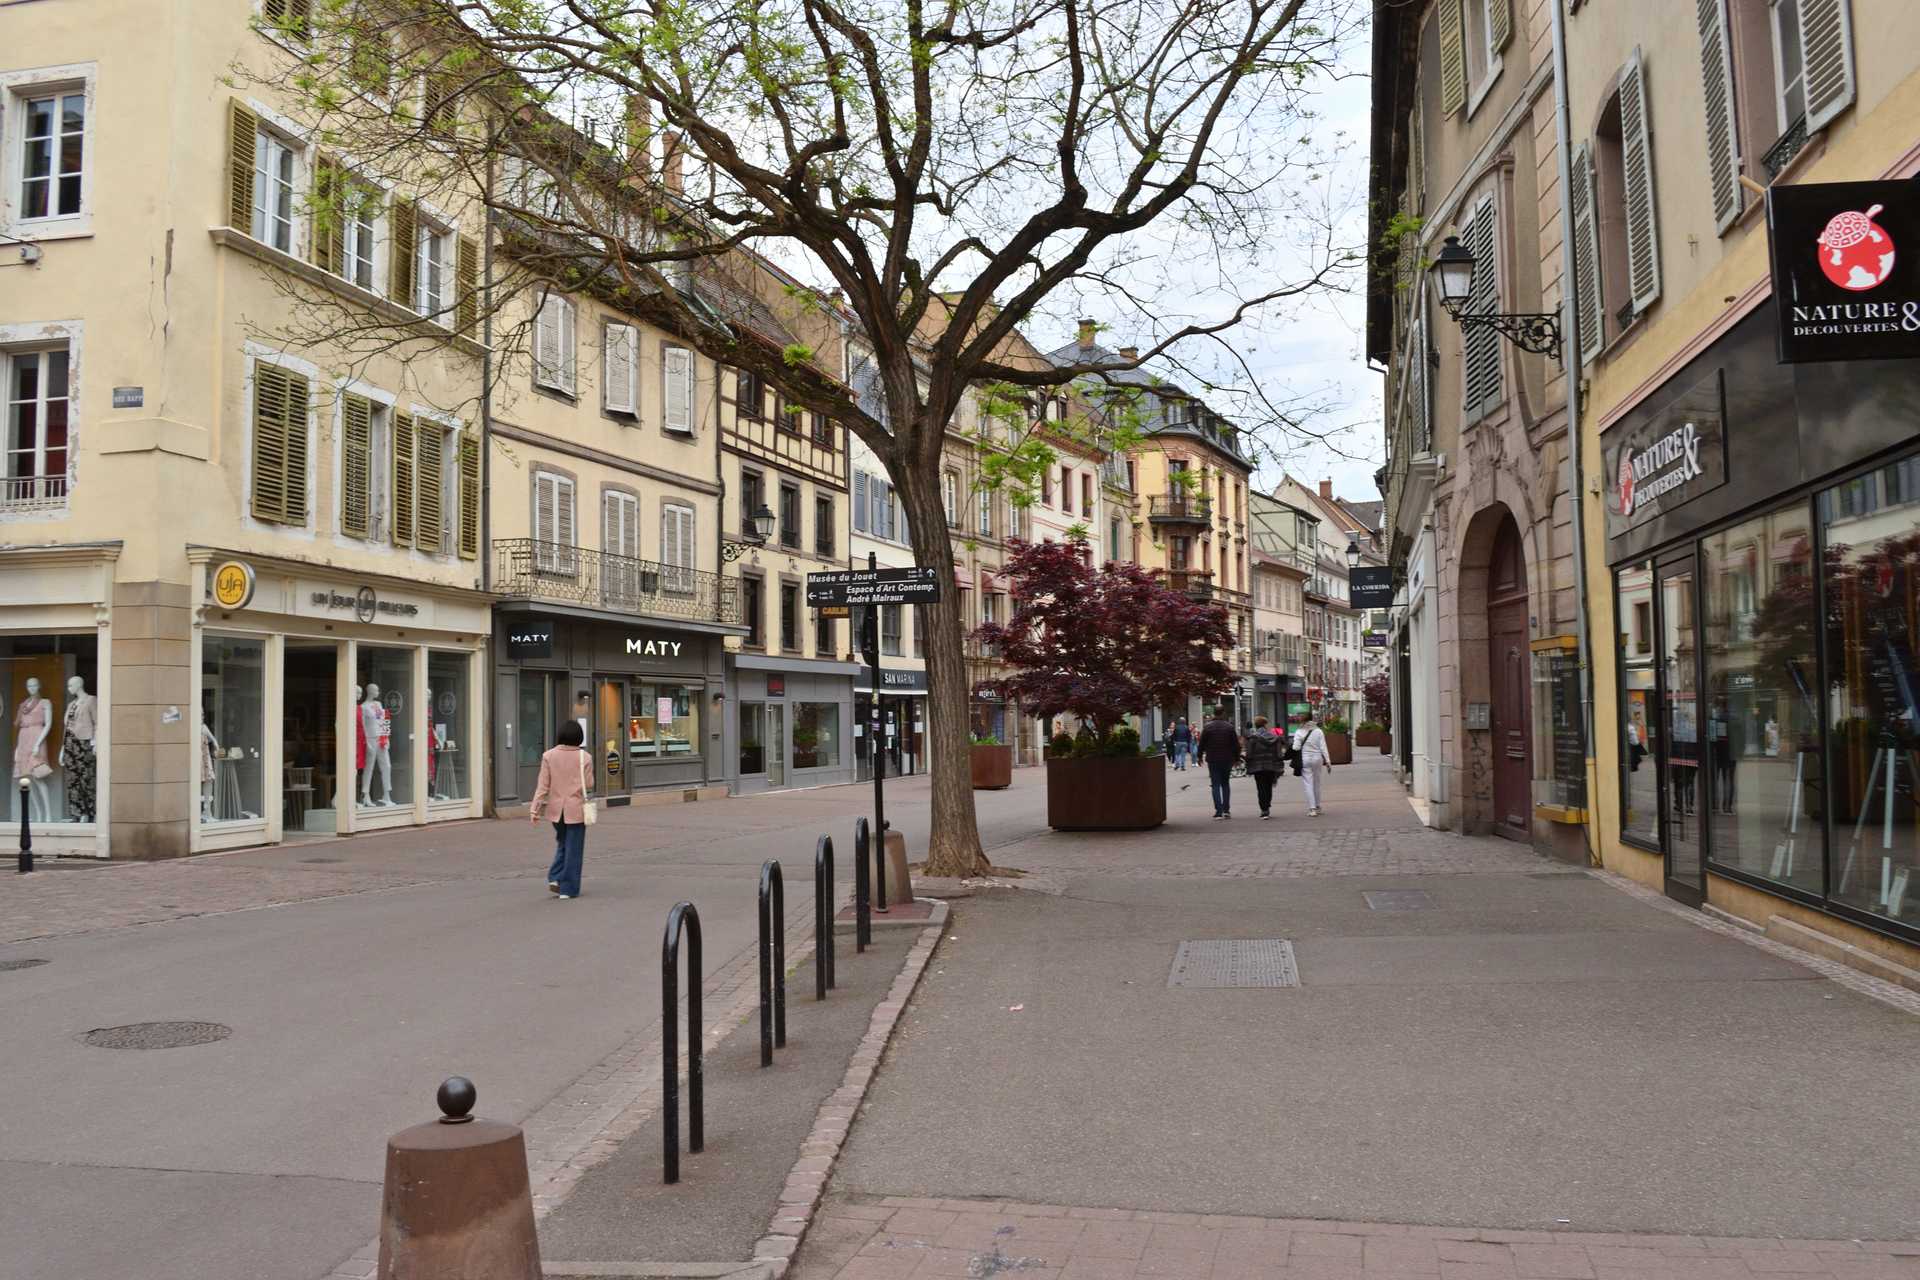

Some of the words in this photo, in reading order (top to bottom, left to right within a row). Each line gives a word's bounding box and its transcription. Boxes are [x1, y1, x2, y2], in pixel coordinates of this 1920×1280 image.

[1793, 302, 1898, 322] NATURE
[1901, 301, 1920, 331] &
[1793, 322, 1900, 336] DECOUVERTES
[1633, 428, 1685, 484] NATURE
[1683, 422, 1703, 481] &
[808, 574, 836, 583] Musée
[839, 574, 850, 582] du
[852, 572, 878, 581] Jouet
[846, 585, 874, 595] Espace
[898, 582, 936, 592] Contemp.
[846, 594, 870, 603] André
[872, 593, 904, 602] Malraux
[511, 634, 550, 643] MATY
[626, 638, 682, 657] MATY
[884, 672, 896, 684] SAN
